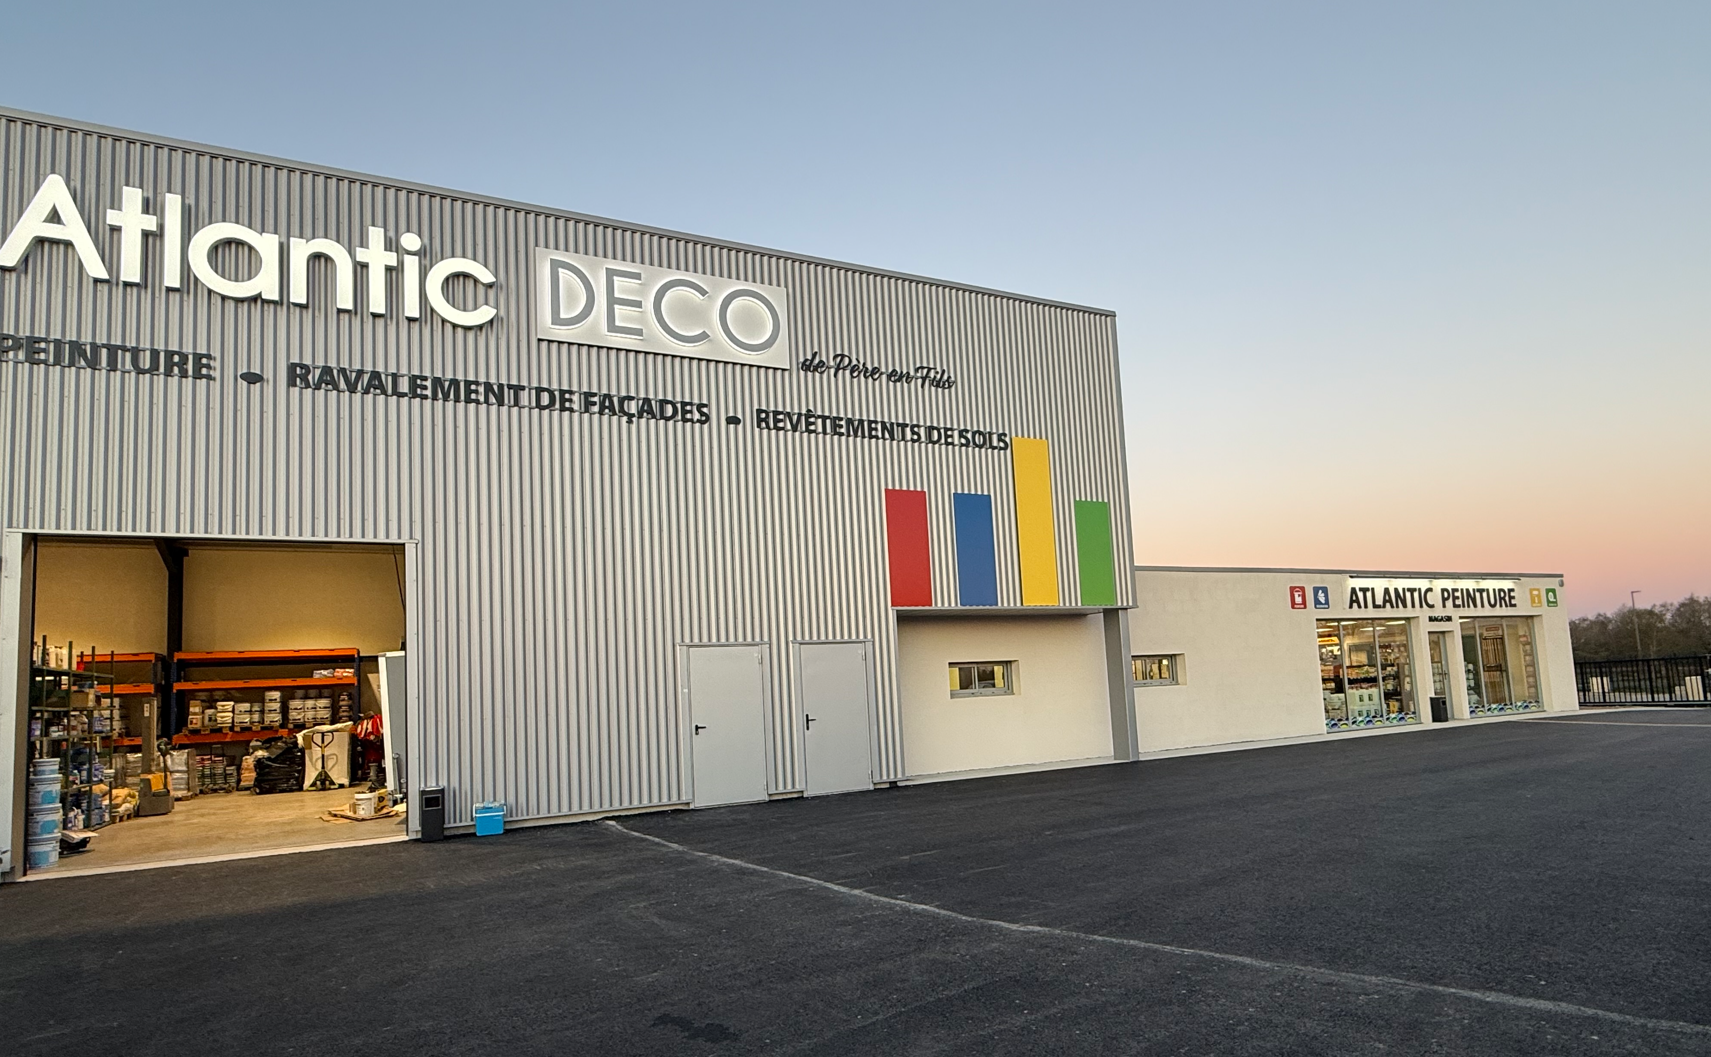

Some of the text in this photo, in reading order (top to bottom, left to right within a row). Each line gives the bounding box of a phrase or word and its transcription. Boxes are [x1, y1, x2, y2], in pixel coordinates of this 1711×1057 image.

[0, 173, 498, 328] Atlantic
[549, 257, 781, 354] DECO
[0, 333, 1009, 451] PEINTURE RAVALEMENT DE FAÇADES REVÊTEMENTS DE SOLS
[800, 351, 955, 389] de Père en Fils
[1348, 586, 1517, 609] ATLANTIC PEINTURE
